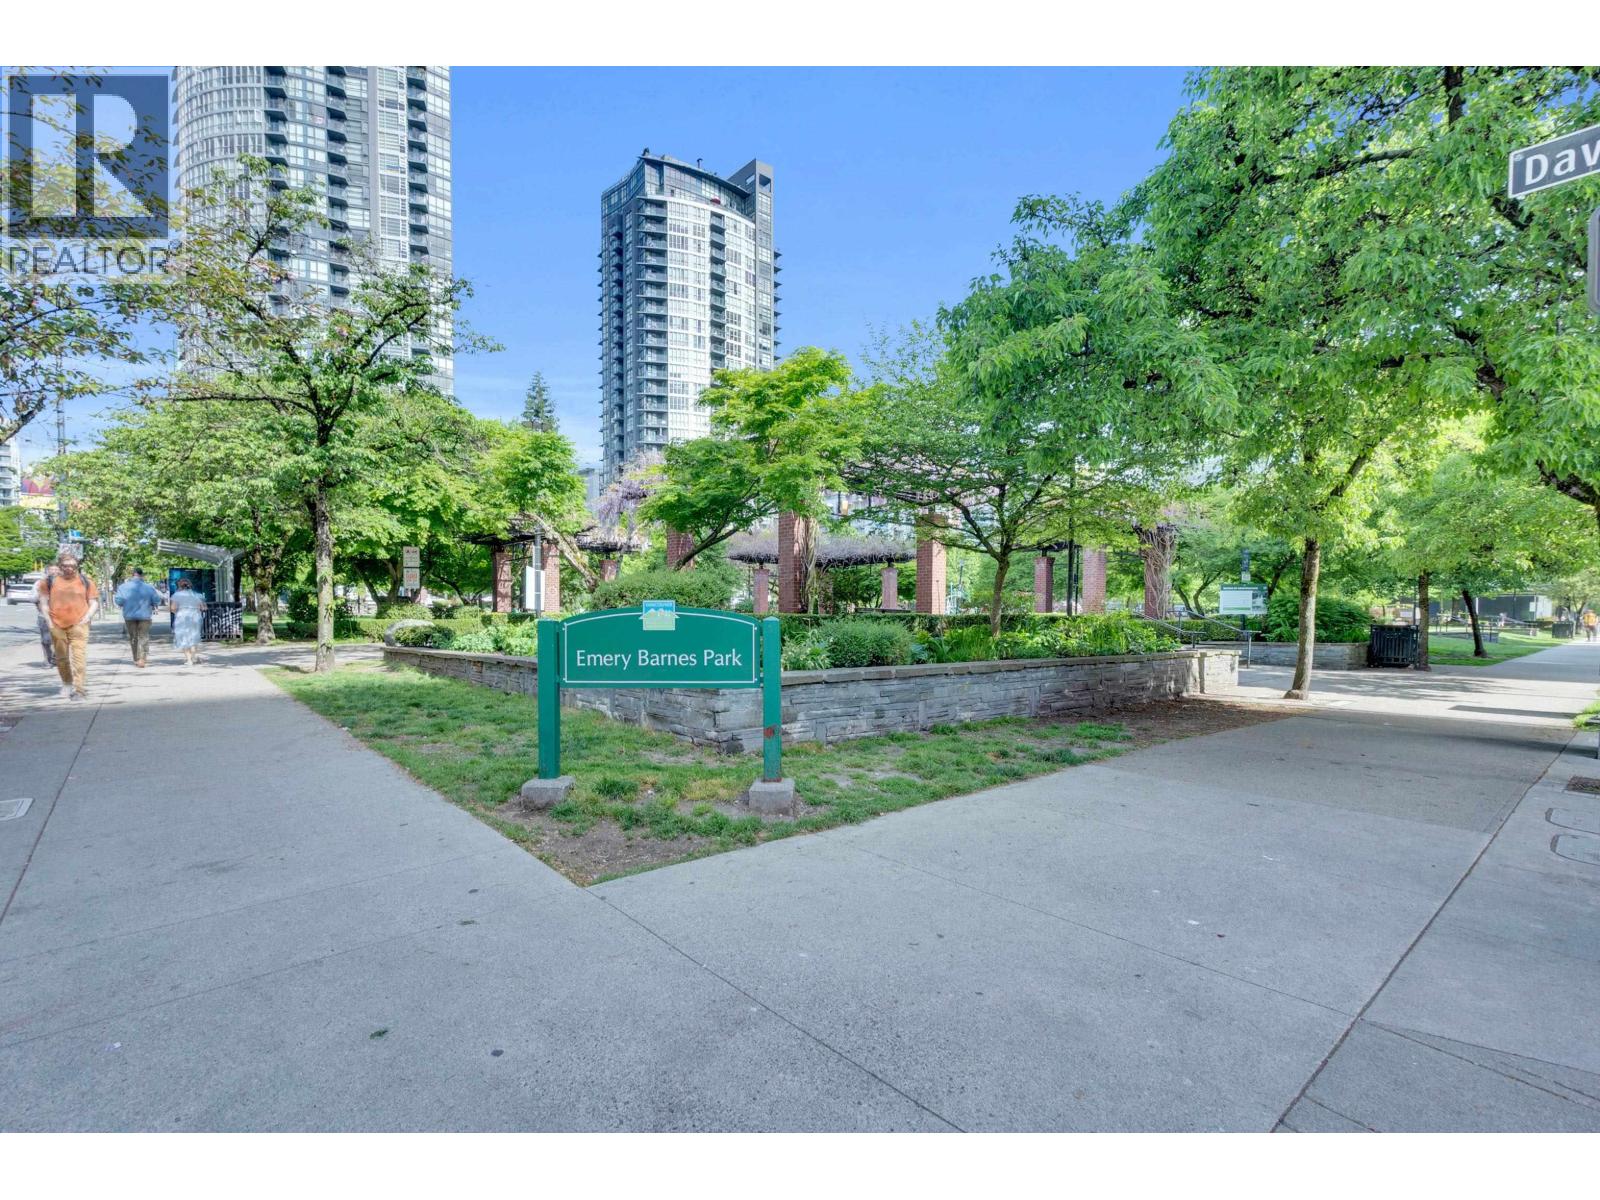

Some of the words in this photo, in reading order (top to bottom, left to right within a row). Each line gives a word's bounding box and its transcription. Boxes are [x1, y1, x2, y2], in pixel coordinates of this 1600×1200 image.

[576, 650, 632, 671] Emery
[638, 649, 697, 666] Barnes
[703, 648, 742, 666] Park
